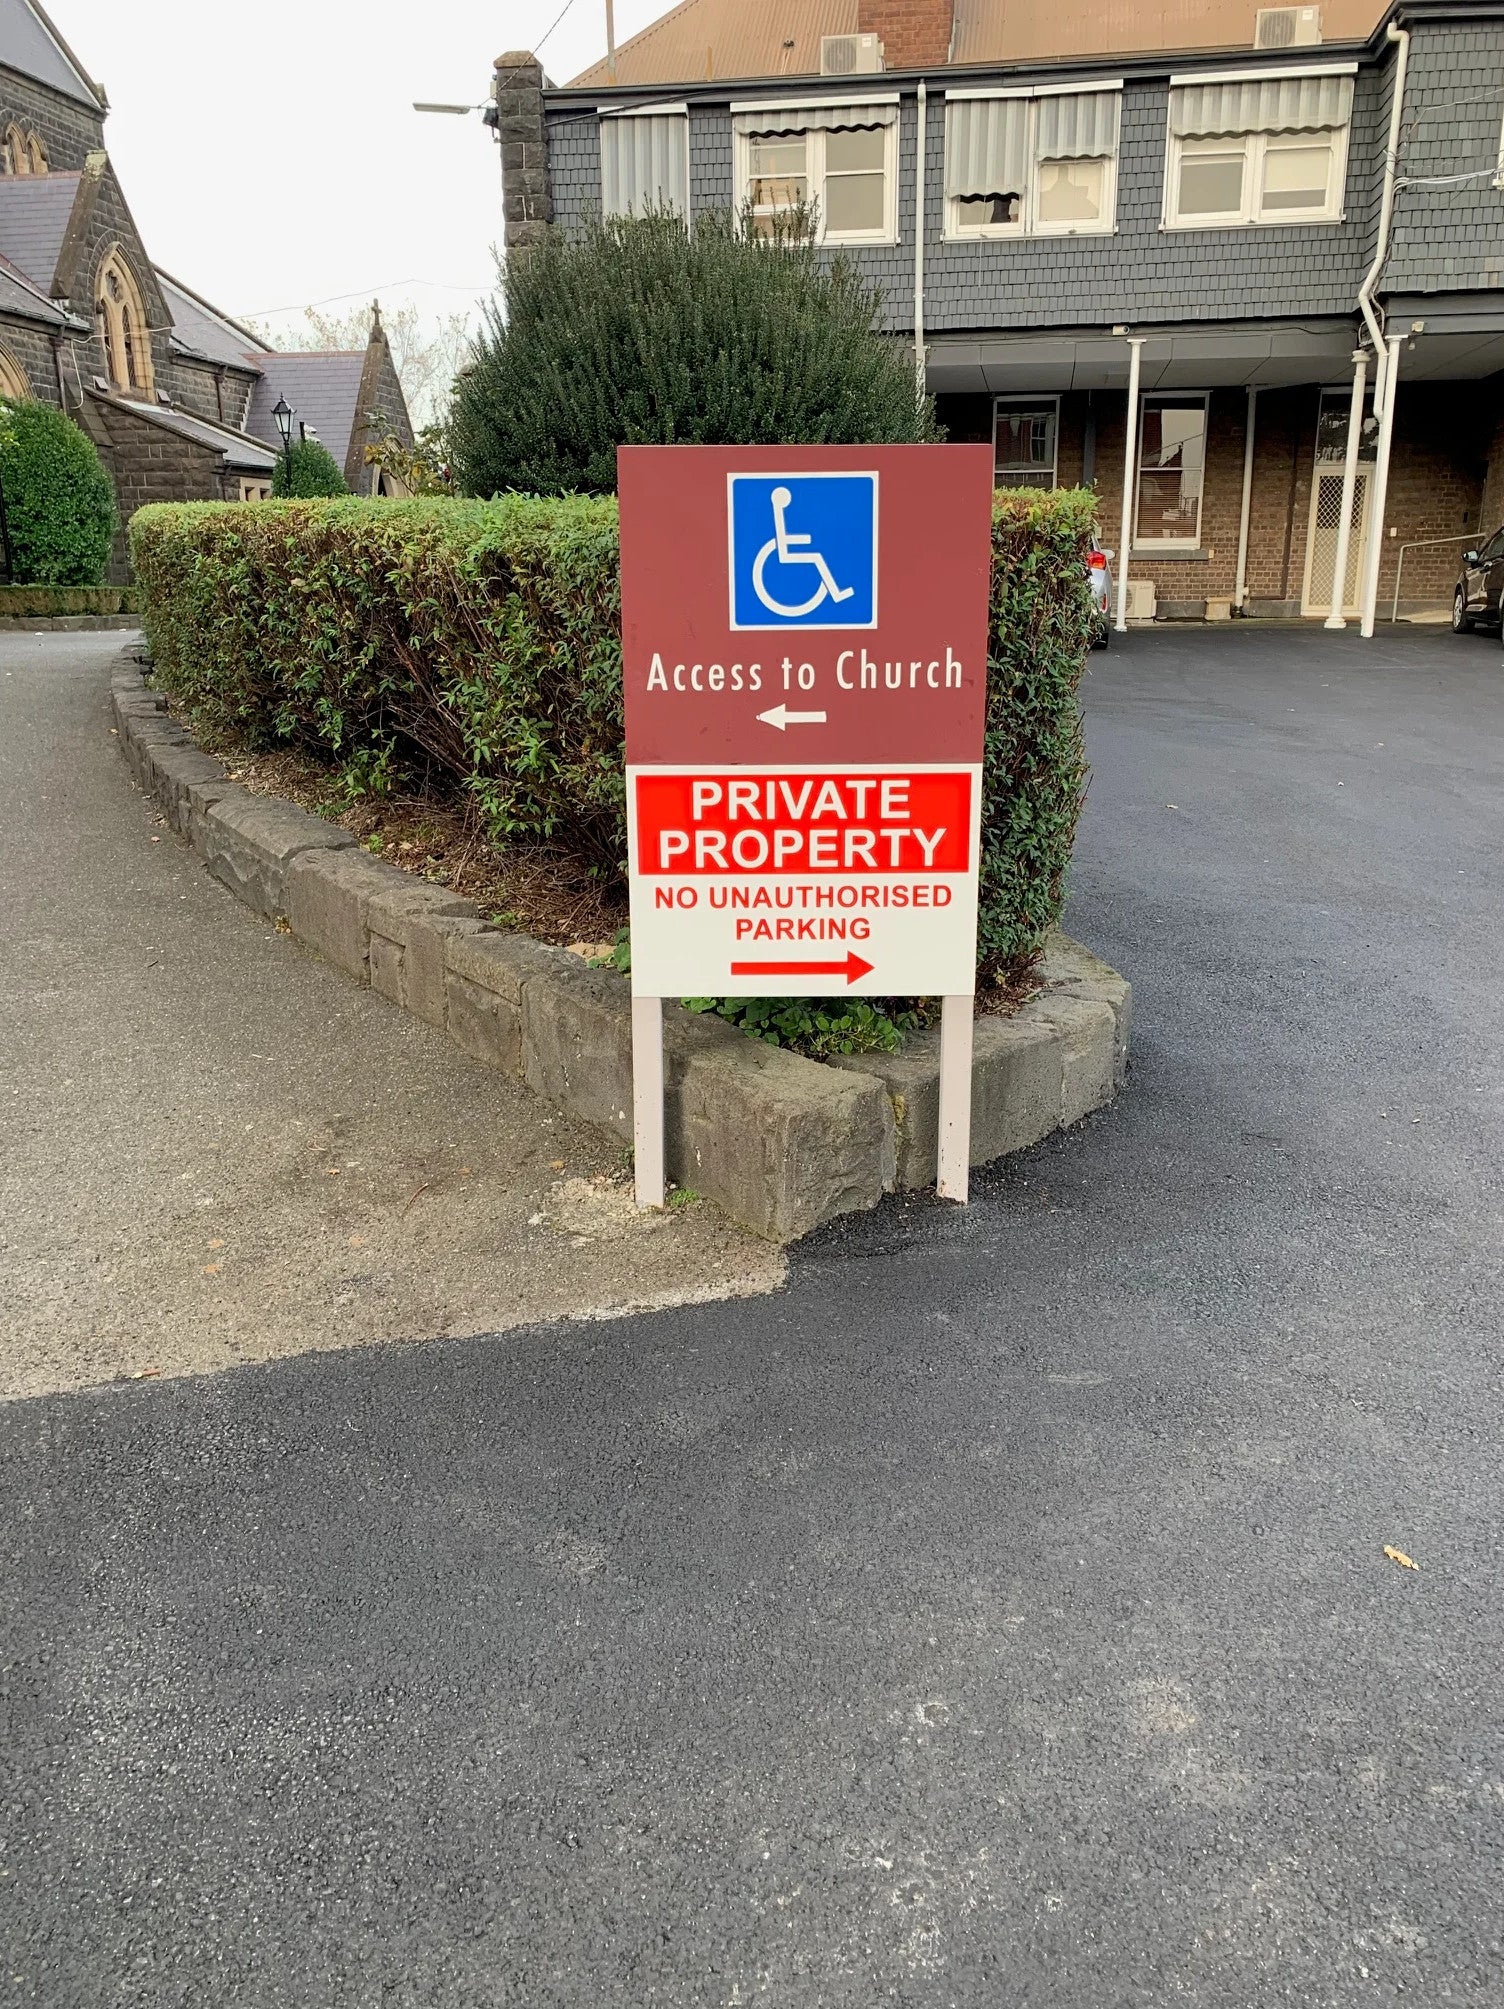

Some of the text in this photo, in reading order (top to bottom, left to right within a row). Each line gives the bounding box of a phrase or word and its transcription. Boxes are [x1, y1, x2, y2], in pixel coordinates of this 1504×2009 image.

[646, 646, 962, 692] Access to Church
[692, 780, 910, 820] PRIVATE
[659, 828, 947, 869] PROPERTY
[655, 884, 952, 909] NO UNAUTHORISED
[736, 917, 871, 941] PARKING
